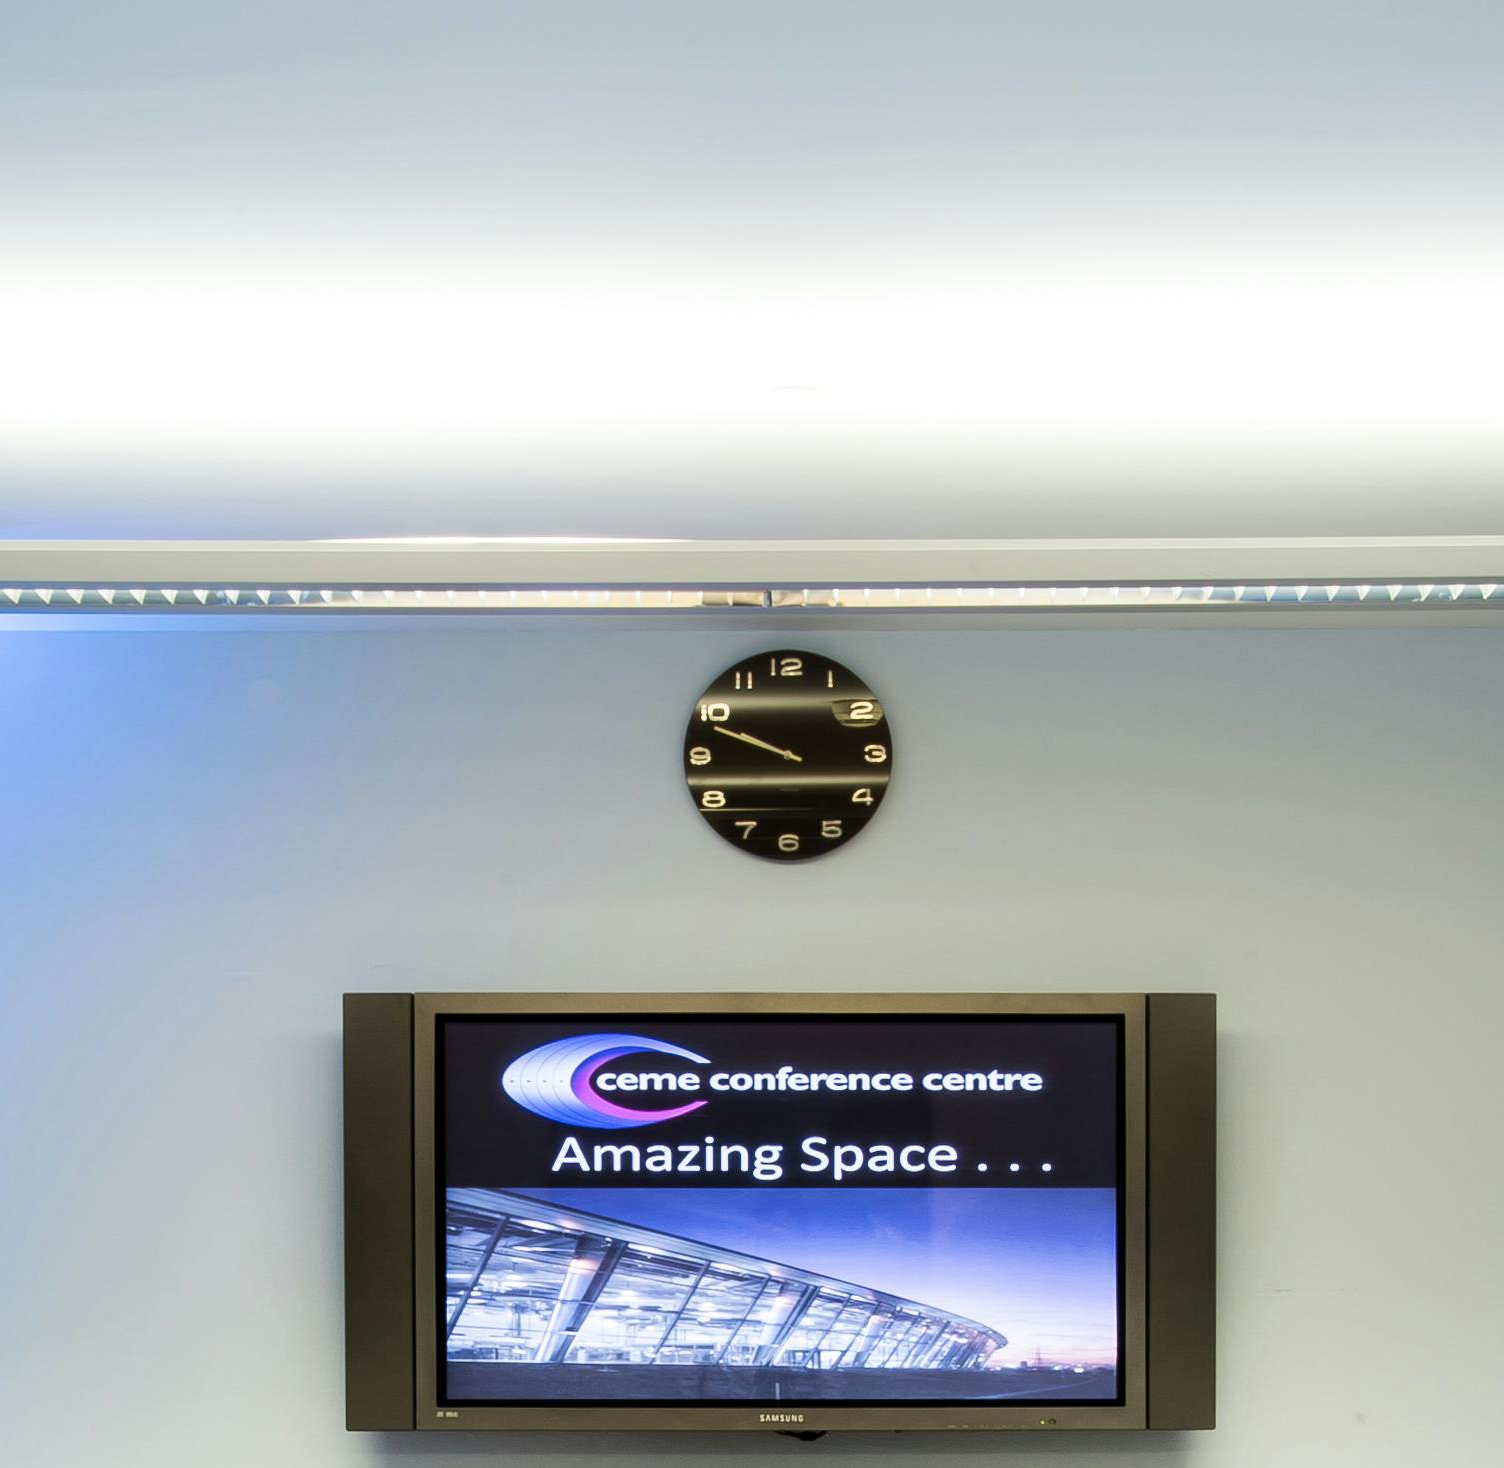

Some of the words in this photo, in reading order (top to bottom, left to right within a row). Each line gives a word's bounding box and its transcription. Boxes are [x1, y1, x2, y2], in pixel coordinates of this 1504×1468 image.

[770, 657, 803, 677] 12
[735, 671, 753, 690] 11
[827, 670, 834, 688] 1
[700, 702, 731, 722] 10
[849, 701, 874, 720] 2
[689, 746, 711, 766] 9
[864, 744, 887, 763] 3
[701, 790, 726, 808] 8
[851, 788, 874, 806] 4
[735, 821, 757, 840] 7
[821, 820, 843, 838] 5
[778, 833, 800, 852] 6
[595, 1069, 700, 1093] ceme
[708, 1064, 912, 1093] conference
[922, 1066, 1042, 1093] centre
[551, 1136, 784, 1180] Amazing
[799, 1136, 958, 1181] Space
[759, 1413, 804, 1423] SAMSUNG
